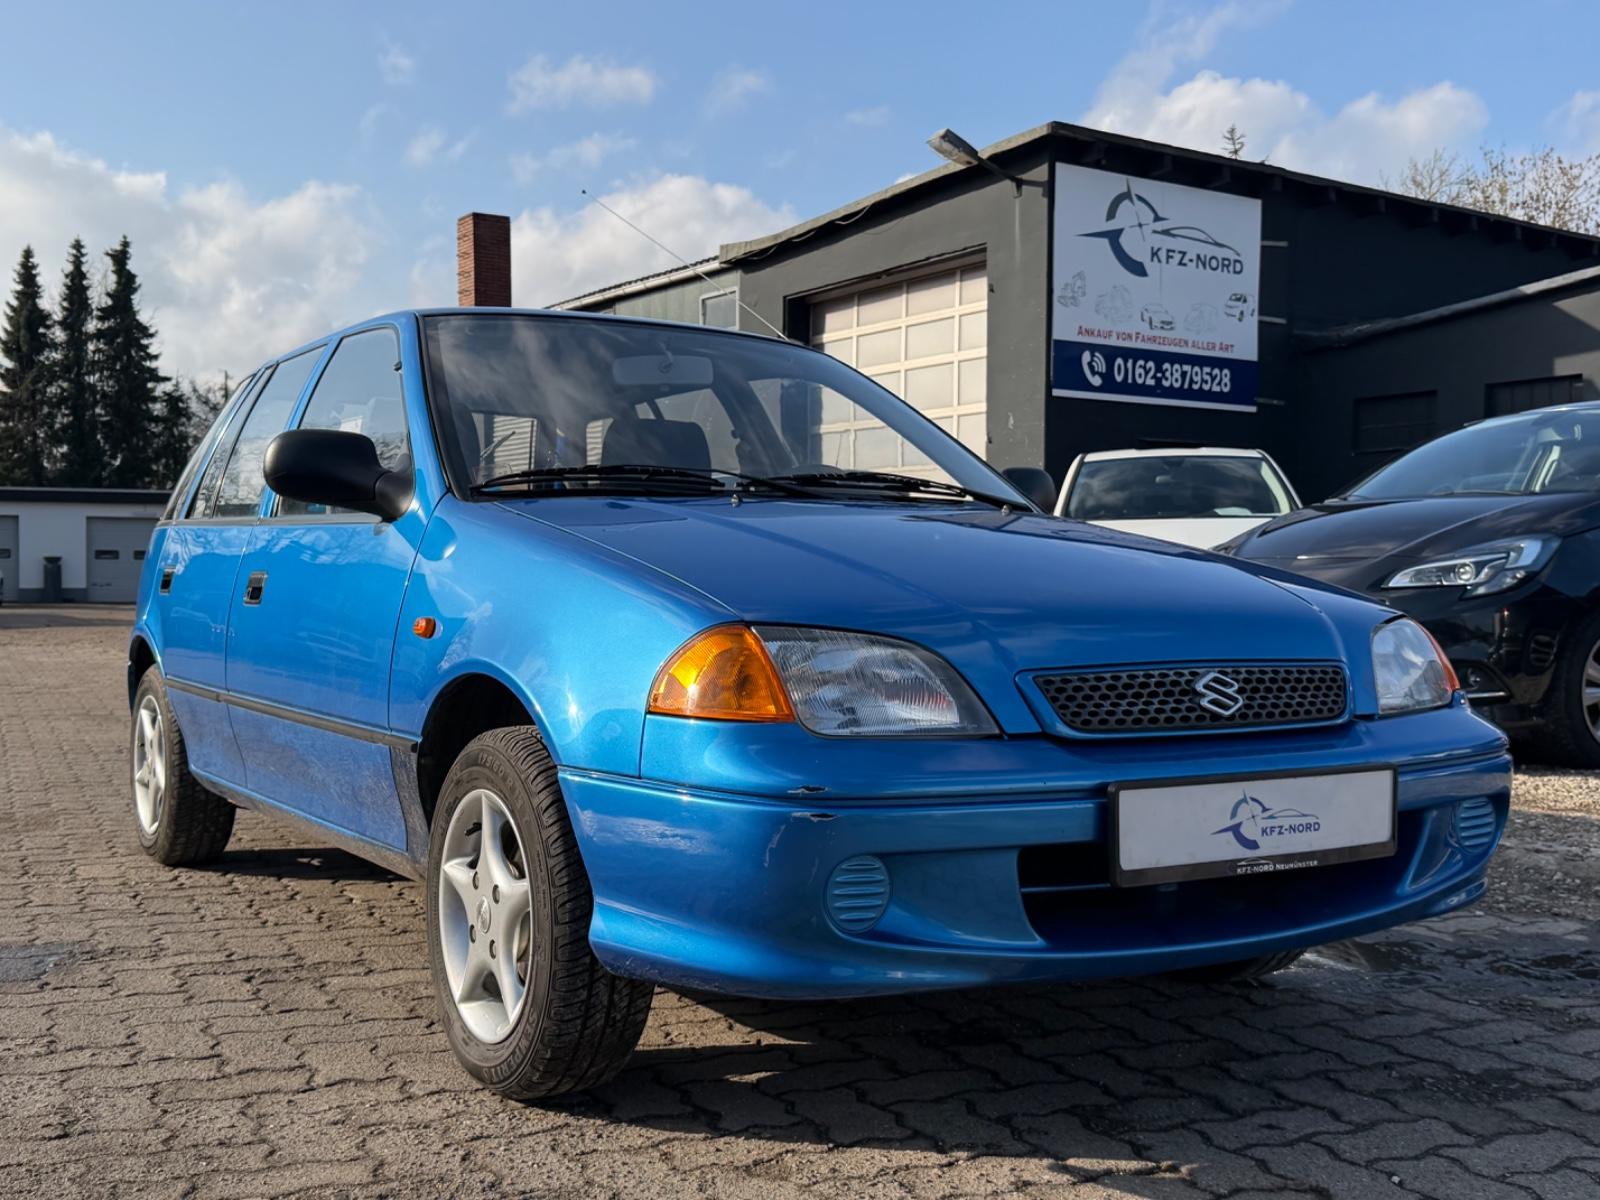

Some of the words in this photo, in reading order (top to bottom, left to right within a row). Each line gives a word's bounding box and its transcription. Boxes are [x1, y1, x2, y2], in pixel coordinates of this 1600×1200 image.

[1150, 246, 1244, 275] KFZ-NORD
[1113, 357, 1232, 393] 0162-3879528
[1260, 821, 1321, 837] KFZ-NORD
[1236, 863, 1274, 875] KFZ-NORD
